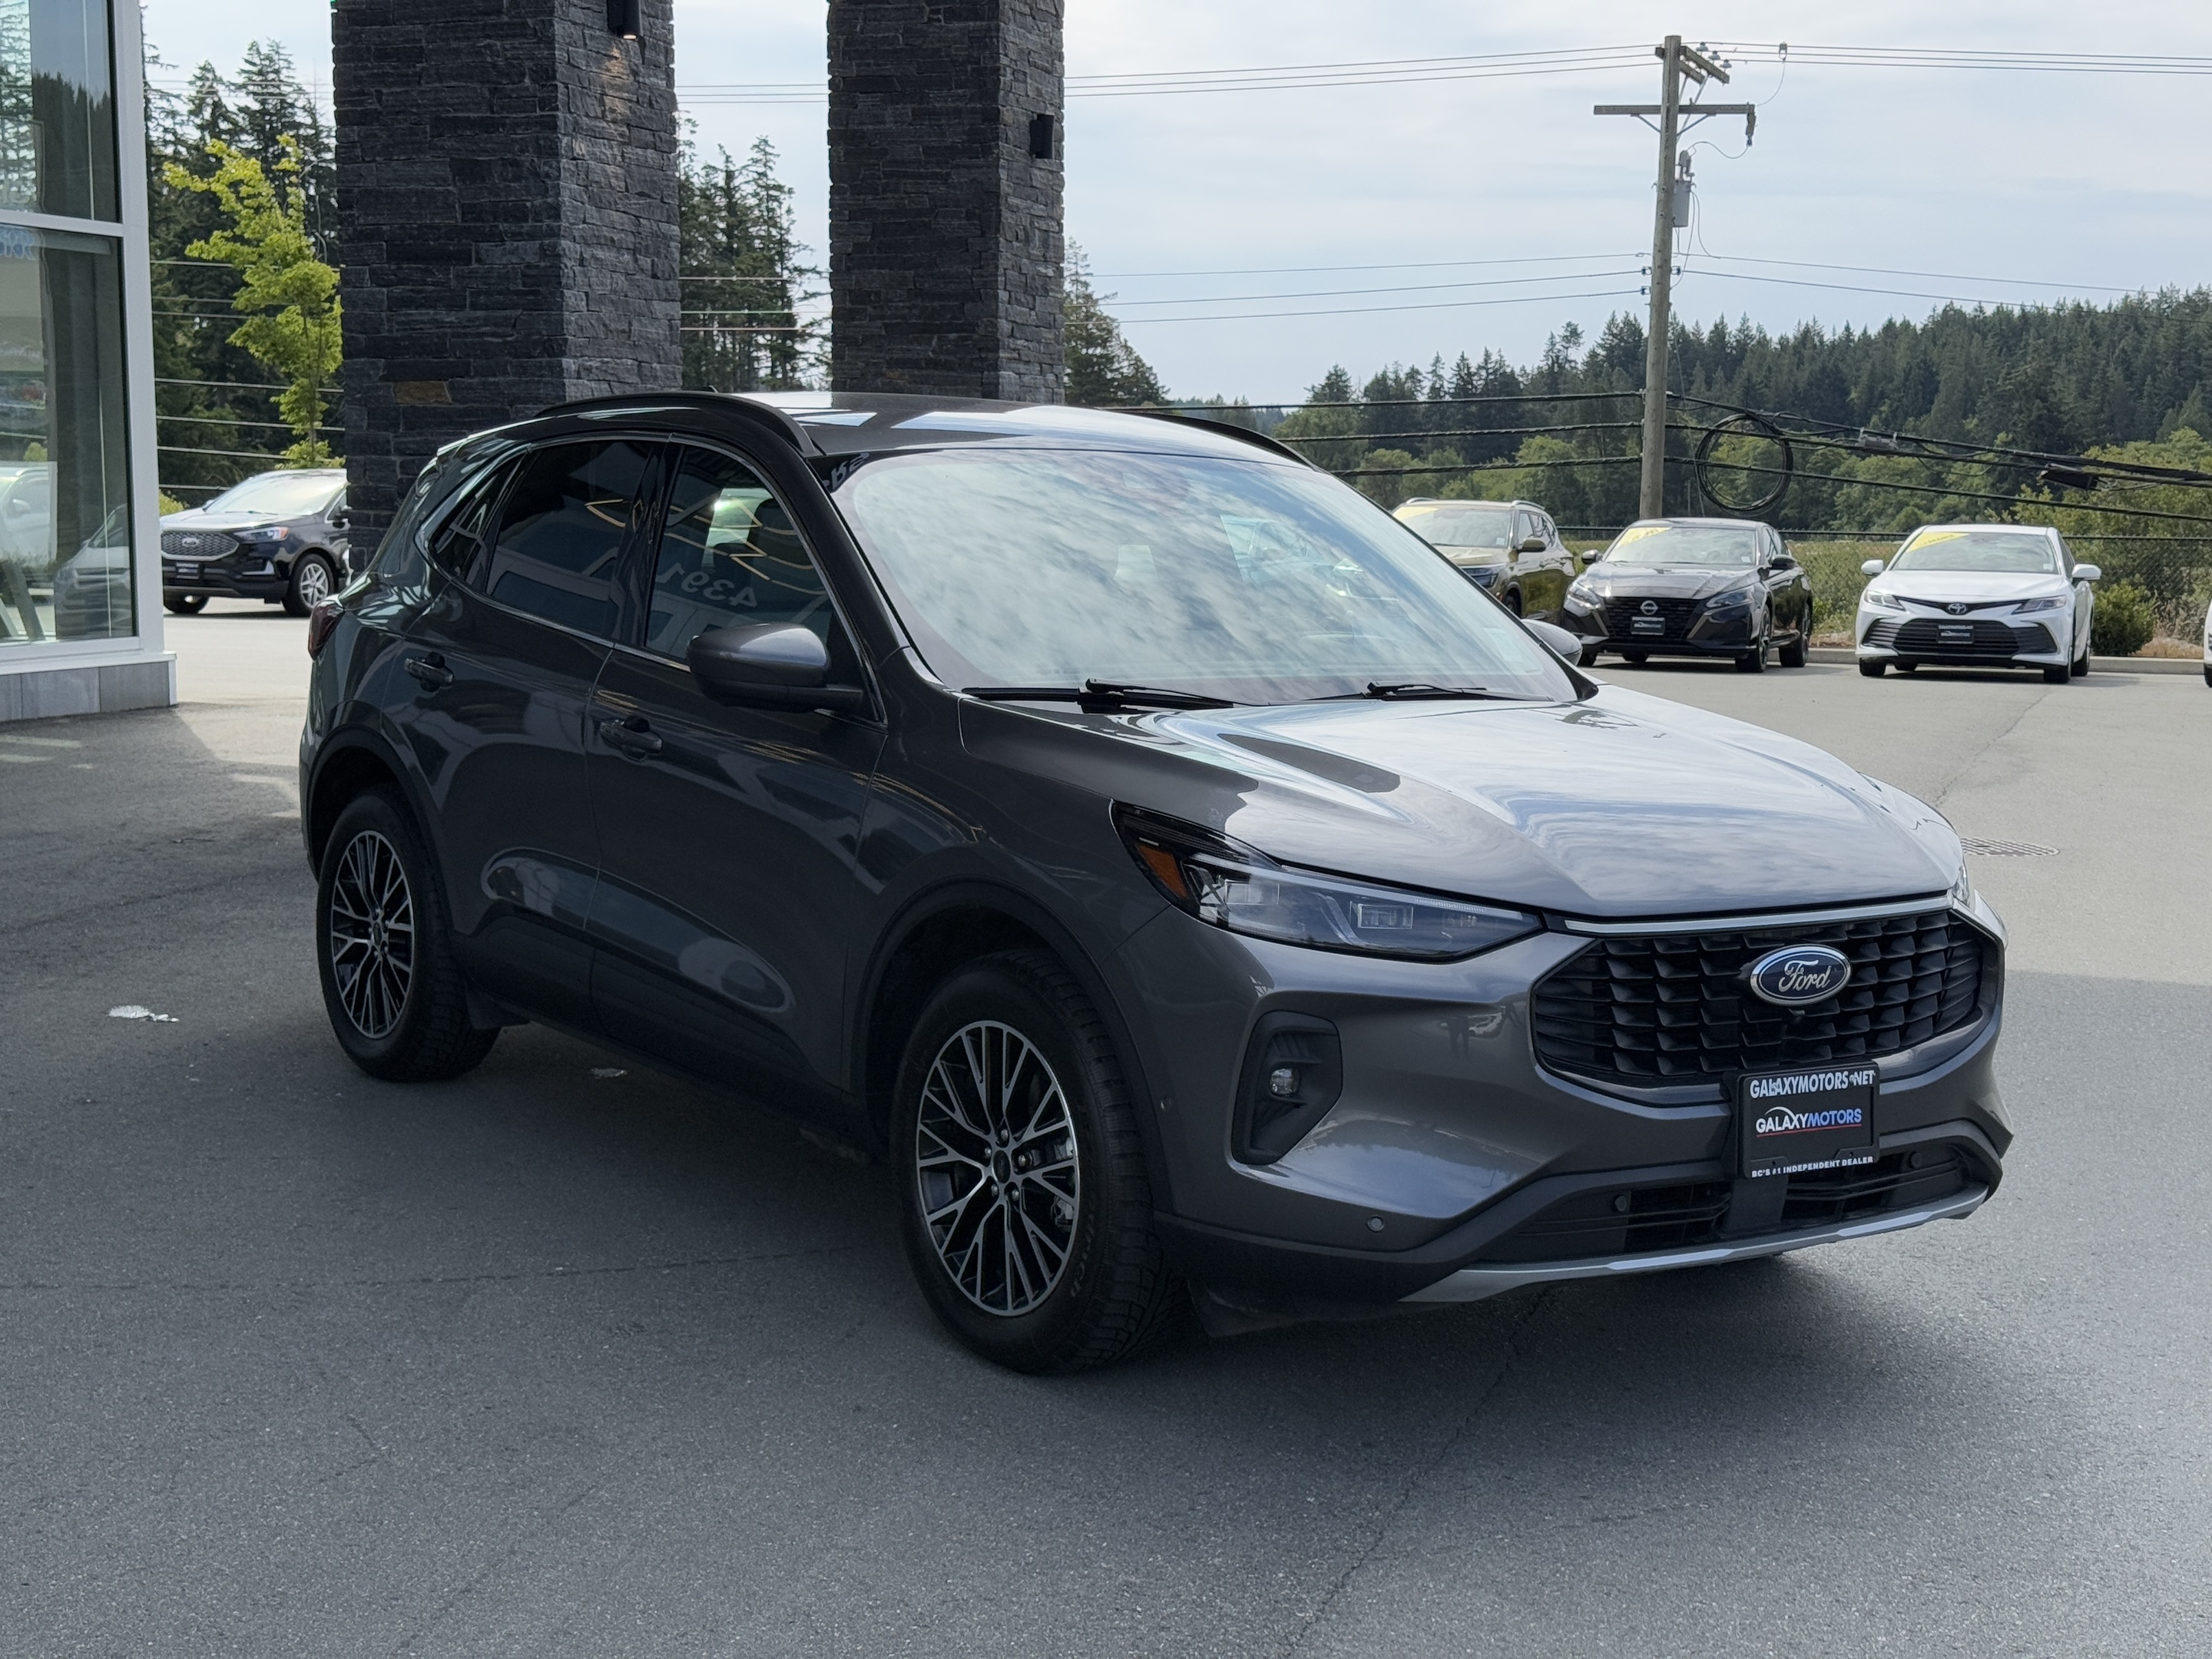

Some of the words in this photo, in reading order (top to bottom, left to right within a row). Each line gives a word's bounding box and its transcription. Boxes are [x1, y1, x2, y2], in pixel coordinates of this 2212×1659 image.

[1778, 959, 1833, 993] Ford
[1750, 1070, 1875, 1099] GALAXYMOTORSNET
[1756, 1107, 1863, 1133] GALAXYMOTORS
[1751, 1168, 1771, 1178] BC'S
[1772, 1167, 1782, 1175] #1
[1783, 1159, 1841, 1174] INDEPENDENT
[1841, 1156, 1874, 1167] DEALER
